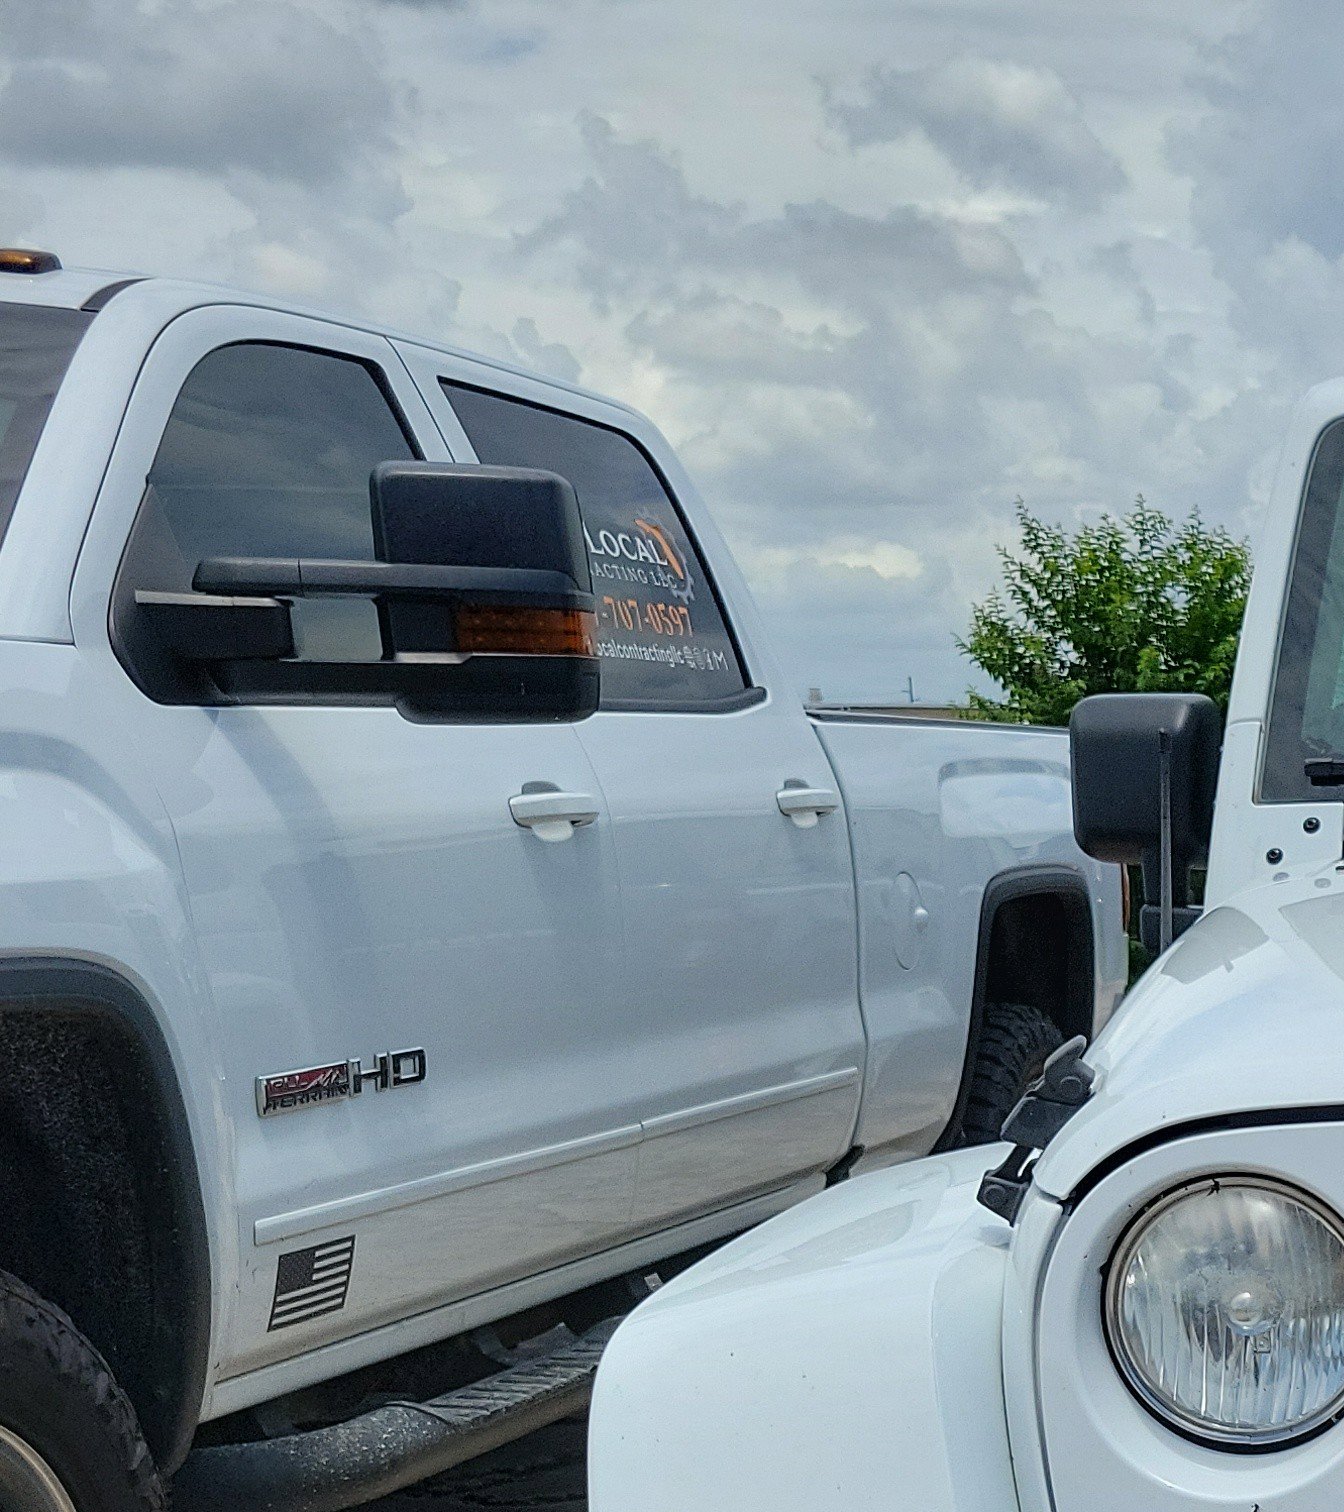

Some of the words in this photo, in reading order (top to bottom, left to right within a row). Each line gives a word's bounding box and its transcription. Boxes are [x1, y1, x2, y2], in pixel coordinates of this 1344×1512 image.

[583, 522, 668, 566] LOCAL
[590, 561, 648, 584] ACTING
[347, 1046, 427, 1098] HD
